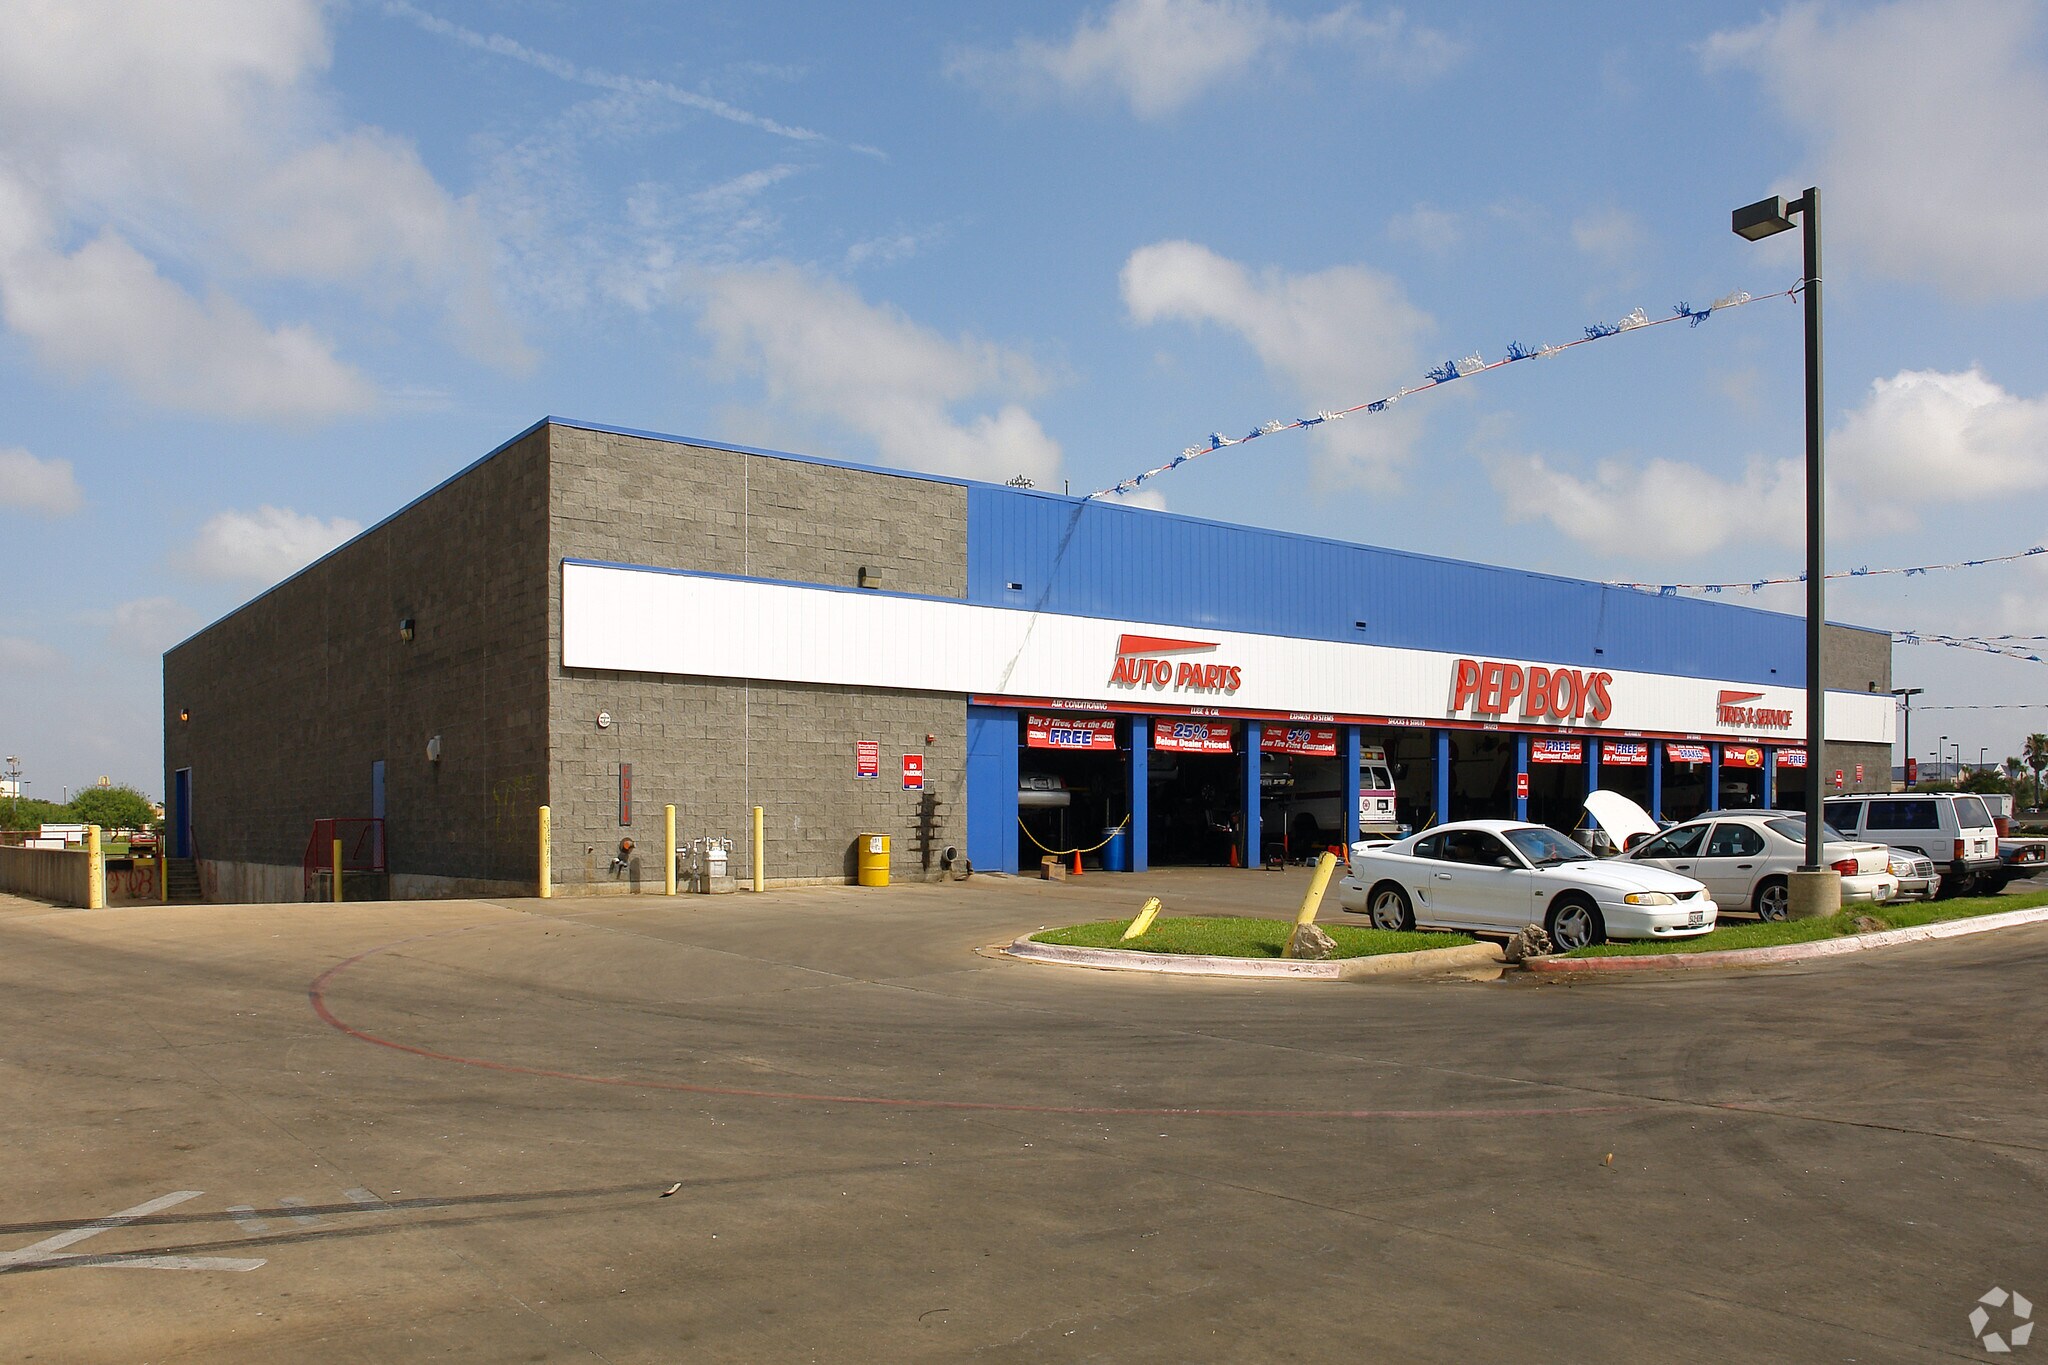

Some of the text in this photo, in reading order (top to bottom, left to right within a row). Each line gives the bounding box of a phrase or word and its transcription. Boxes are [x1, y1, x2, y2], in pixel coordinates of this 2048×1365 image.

[1111, 656, 1242, 691] AUTO PARTS
[1453, 659, 1613, 722] PEP BOYS
[1051, 699, 1108, 710] AIR CONDITIONING
[1028, 715, 1043, 727] Buy
[1051, 718, 1071, 729] Tires,
[1072, 720, 1086, 728] Get
[1087, 721, 1100, 729] the
[1101, 720, 1115, 729] 4th
[1312, 714, 1334, 722] SYSTEMS
[1719, 705, 1793, 727] TIRES & SERVICE
[1049, 728, 1094, 746] FREE
[1173, 722, 1209, 740] 25%
[1286, 728, 1312, 742] 5%
[1155, 735, 1230, 749] Below Dealer Prices!
[1260, 738, 1274, 747] Low
[1274, 740, 1285, 748] Tire
[1285, 740, 1301, 749] Price
[1301, 742, 1335, 752] Guarantee!
[1545, 739, 1571, 752] FREE
[1615, 743, 1638, 755] FREE
[1532, 751, 1581, 760] Alignment Checks!
[1602, 753, 1611, 761] Air
[1788, 754, 1806, 766] FREE
